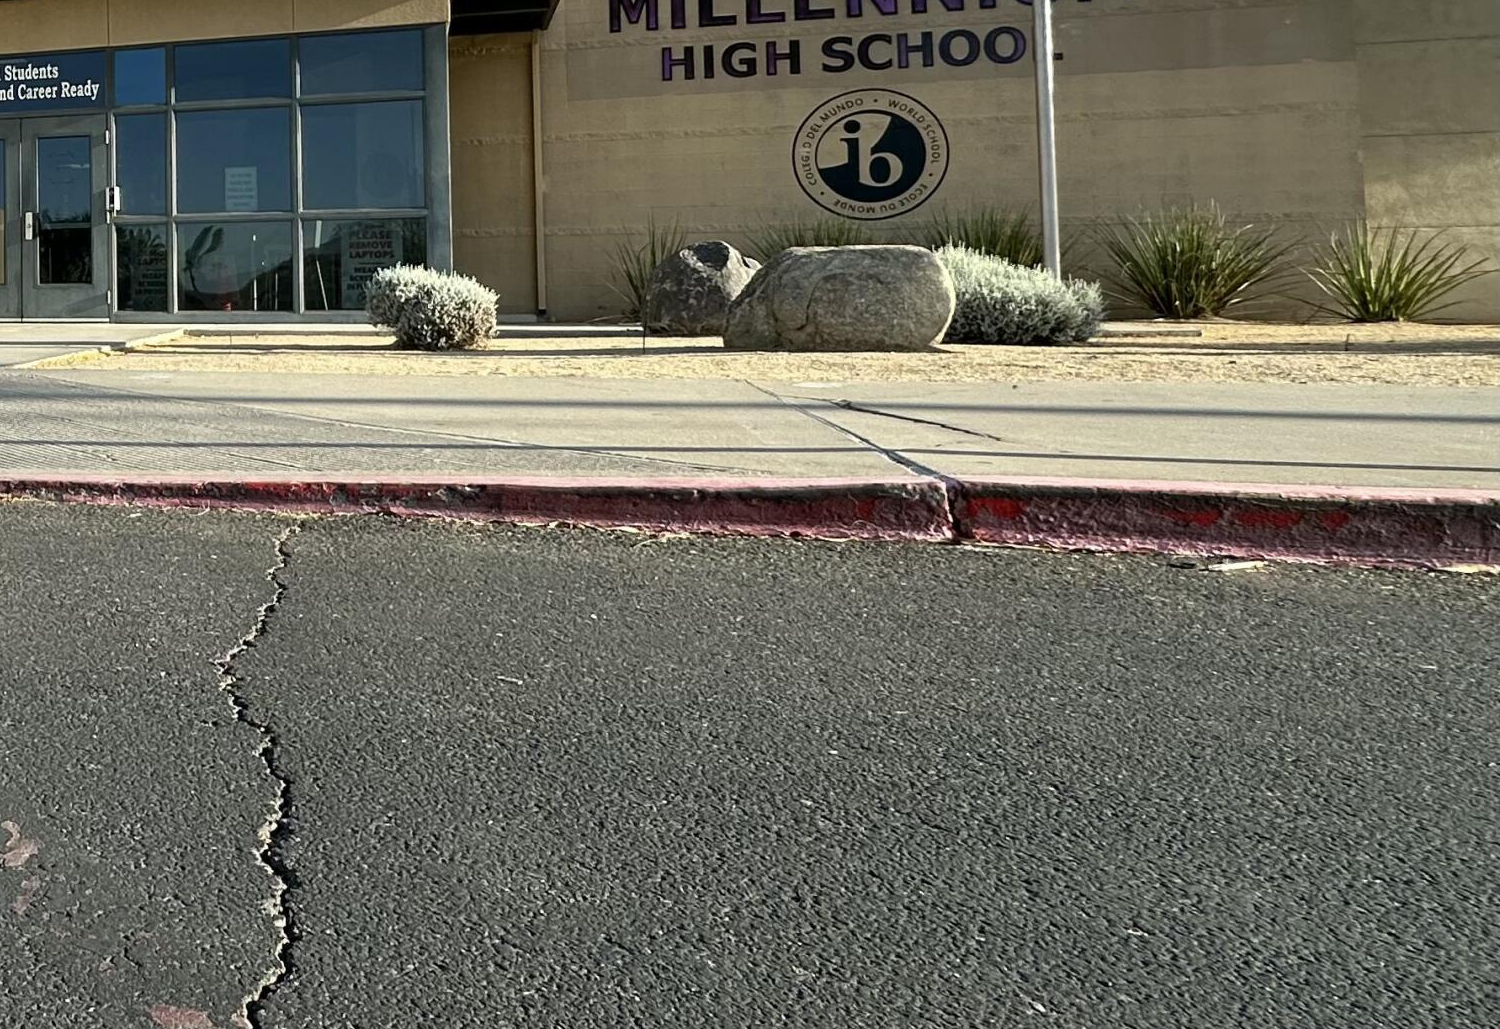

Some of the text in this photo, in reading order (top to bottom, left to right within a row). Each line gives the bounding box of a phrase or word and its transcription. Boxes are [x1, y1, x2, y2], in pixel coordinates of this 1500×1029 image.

[661, 25, 1063, 82] HIGH SCHOO
[4, 63, 59, 82] Students
[17, 83, 57, 100] Career
[60, 79, 100, 101] Ready
[807, 123, 822, 140] DEL
[819, 98, 864, 123] MUNDO
[888, 98, 941, 164] WORLD SCHOOL
[833, 199, 875, 214] MONDE
[880, 204, 896, 216] DU
[349, 250, 396, 260] LAPTOPS
